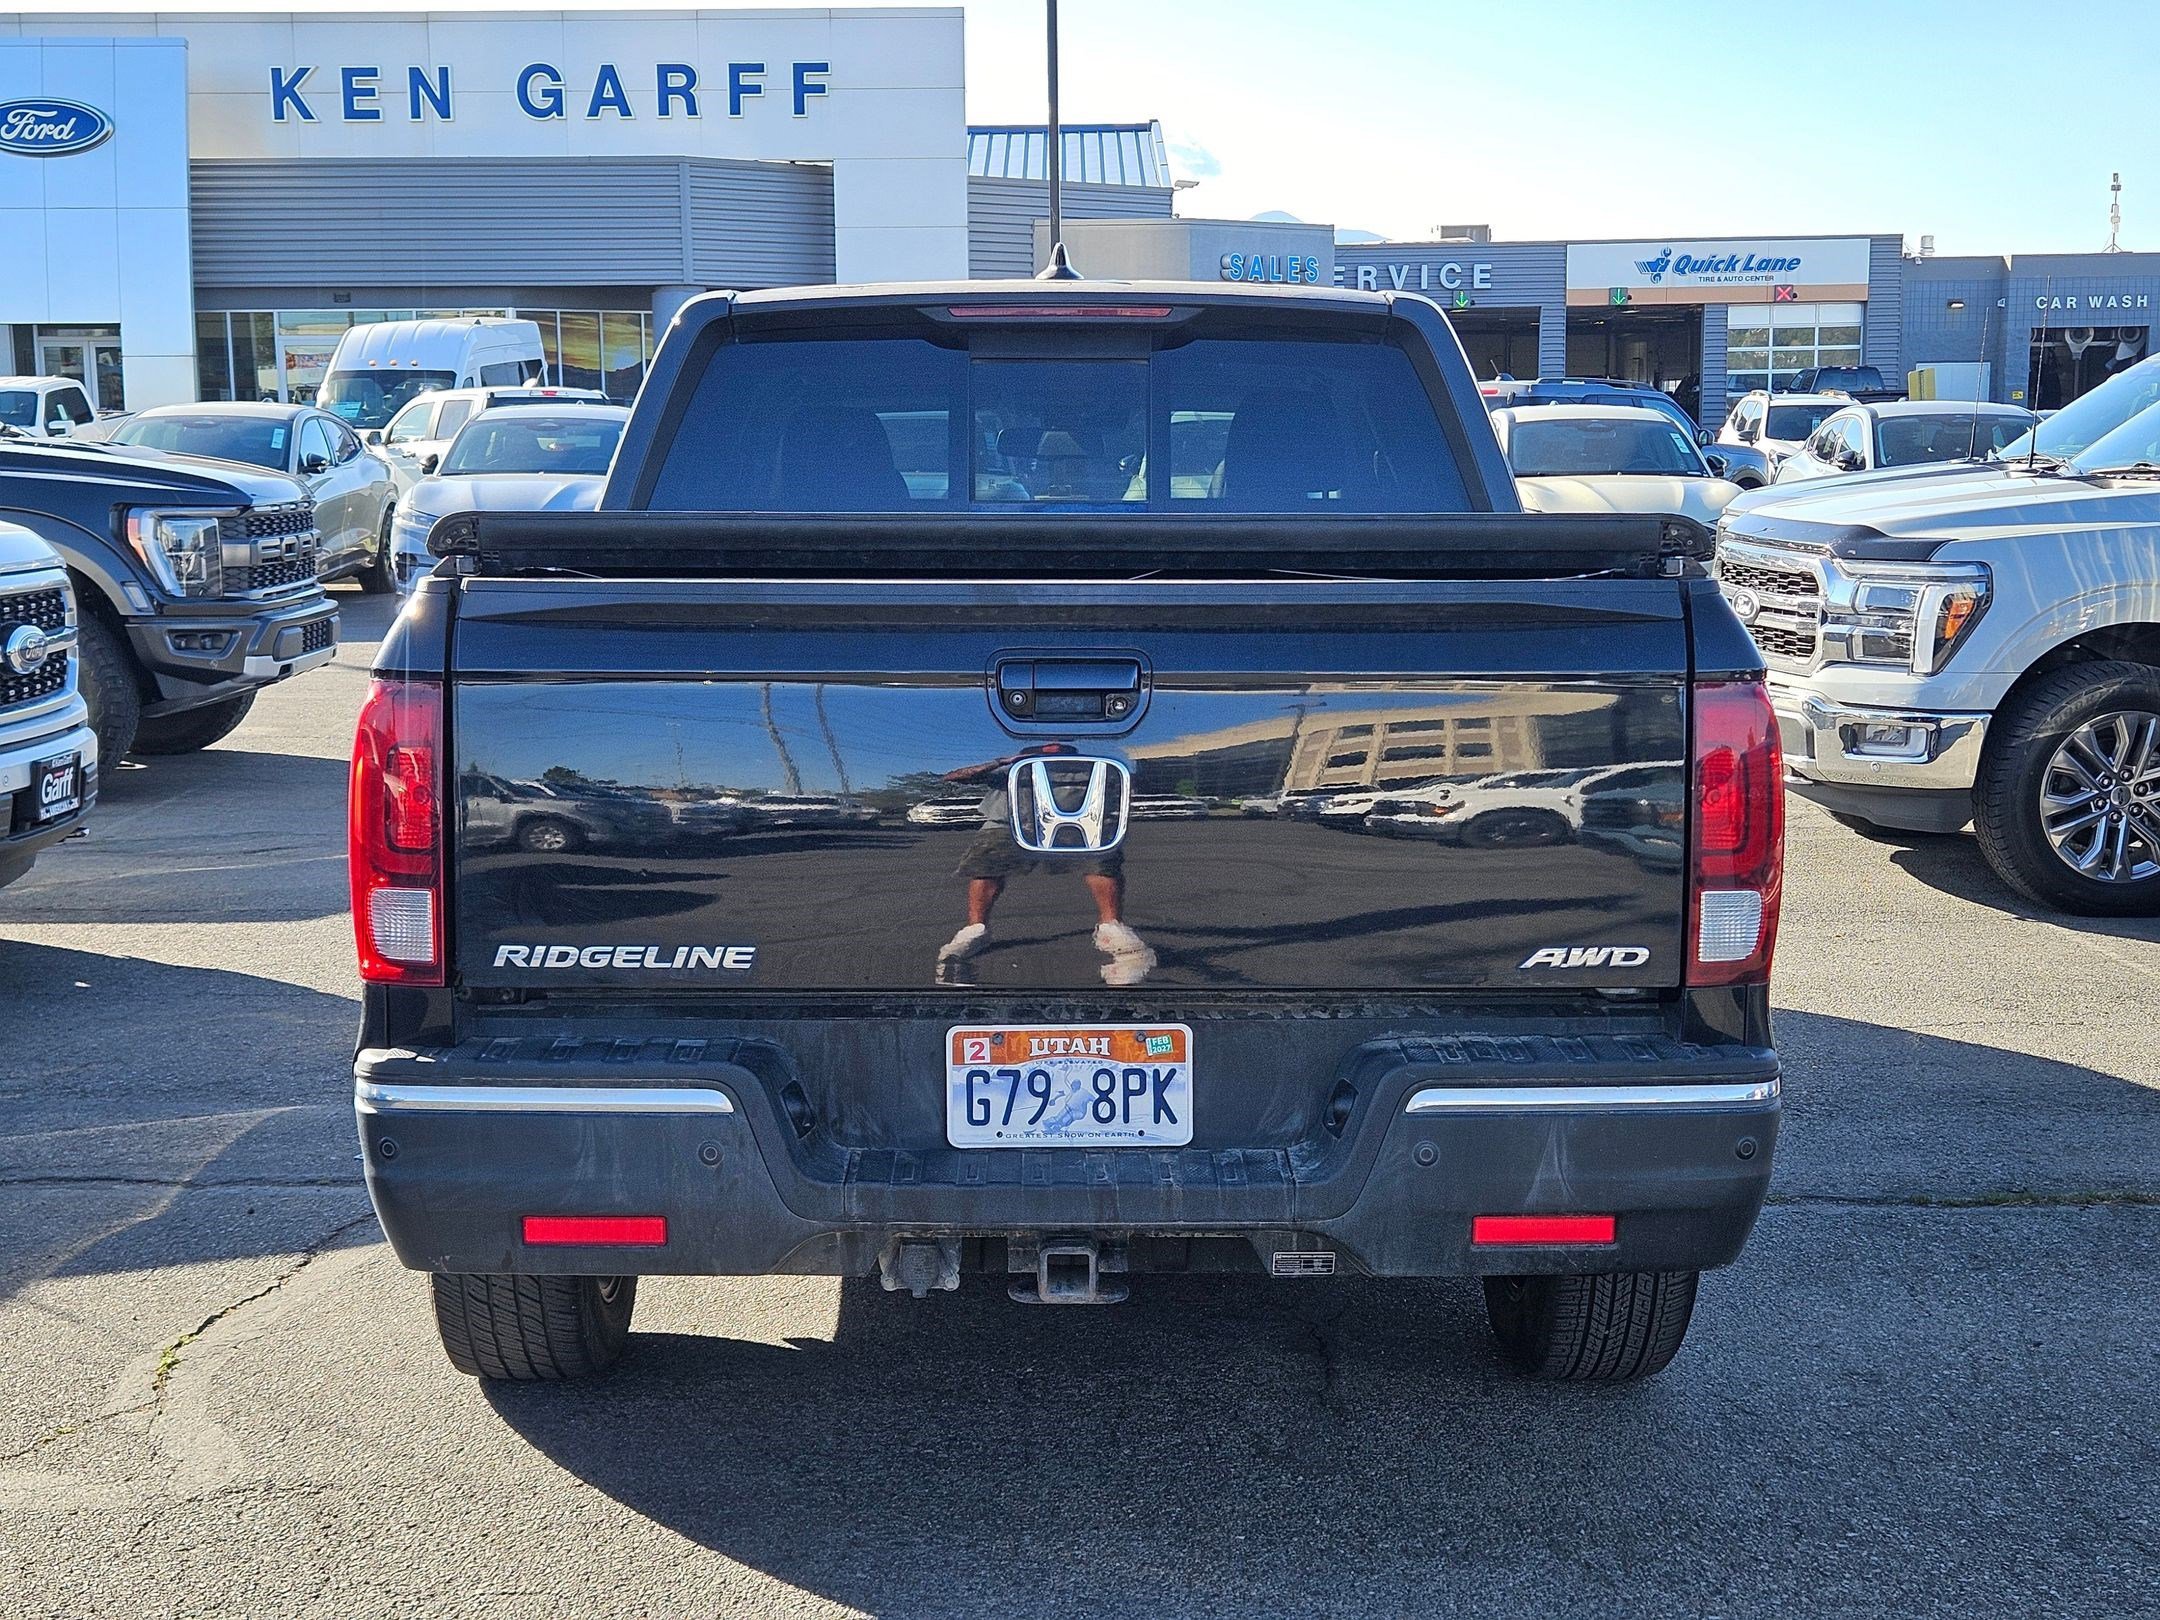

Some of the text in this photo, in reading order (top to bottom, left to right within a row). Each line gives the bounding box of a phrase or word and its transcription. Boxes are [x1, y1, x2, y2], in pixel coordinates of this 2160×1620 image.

[269, 60, 831, 123] KEN GARFF
[0, 109, 77, 140] Ford
[1225, 252, 1321, 283] SALES
[1672, 253, 1801, 275] Quick Lane
[2035, 295, 2149, 309] CAR WASH
[41, 766, 74, 804] Garff
[493, 945, 756, 969] RIDGELINE
[1519, 947, 1650, 969] AWD
[969, 1041, 986, 1061] 2
[1028, 1037, 1112, 1056] UTAH
[1152, 1036, 1169, 1045] FEB
[1152, 1045, 1171, 1054] 2027
[965, 1067, 1178, 1126] G79 8PK
